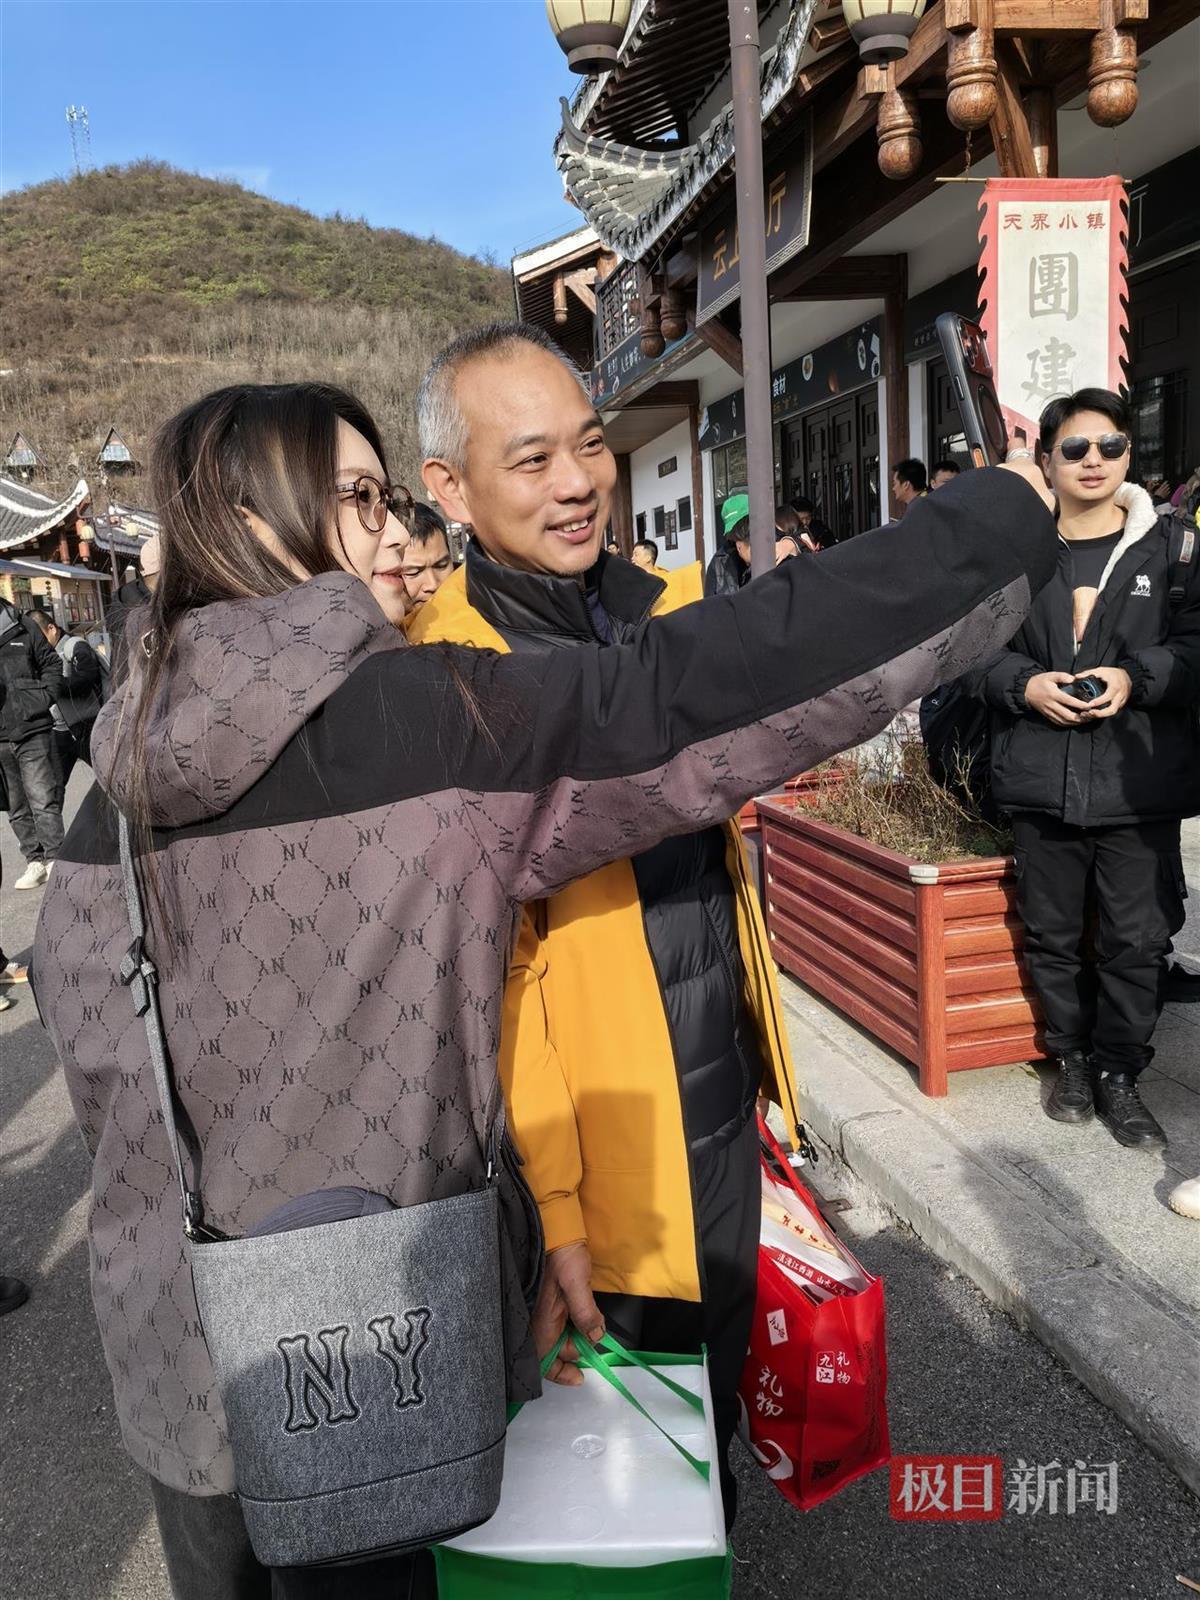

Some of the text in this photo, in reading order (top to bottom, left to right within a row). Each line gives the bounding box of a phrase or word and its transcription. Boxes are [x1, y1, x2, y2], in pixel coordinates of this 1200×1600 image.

[1003, 212, 1106, 231] 天界小镇
[436, 808, 465, 830] NY
[358, 825, 386, 848] NY
[499, 825, 514, 852] NY
[282, 841, 309, 861] NY
[399, 854, 427, 877] NY
[325, 871, 350, 891] NY
[250, 884, 275, 903] NY
[436, 883, 465, 904] NY
[358, 902, 386, 924] NY
[290, 914, 317, 935] NY
[470, 922, 499, 945] NY
[221, 926, 243, 944] NY
[399, 928, 425, 949] NY
[258, 956, 285, 977] NY
[324, 948, 347, 968] NY
[436, 955, 458, 979] NY
[358, 973, 386, 998] NY
[83, 1006, 102, 1021] NY
[225, 999, 251, 1018] NY
[398, 1003, 425, 1022] NY
[319, 1023, 348, 1043] NY
[199, 1039, 220, 1055] NY
[361, 1044, 389, 1065] NY
[121, 1073, 140, 1088] NY
[238, 1068, 261, 1084] NY
[282, 1067, 309, 1085] NY
[401, 1075, 427, 1094] NY
[213, 1103, 234, 1119] NY
[364, 1115, 391, 1133] NY
[126, 1140, 144, 1154] NY
[120, 1225, 138, 1242] NY
[276, 1305, 434, 1436] NY
[818, 1353, 834, 1382] 九江
[836, 1351, 851, 1384] 礼物
[756, 1365, 784, 1417] 礼物
[186, 1394, 208, 1412] NY
